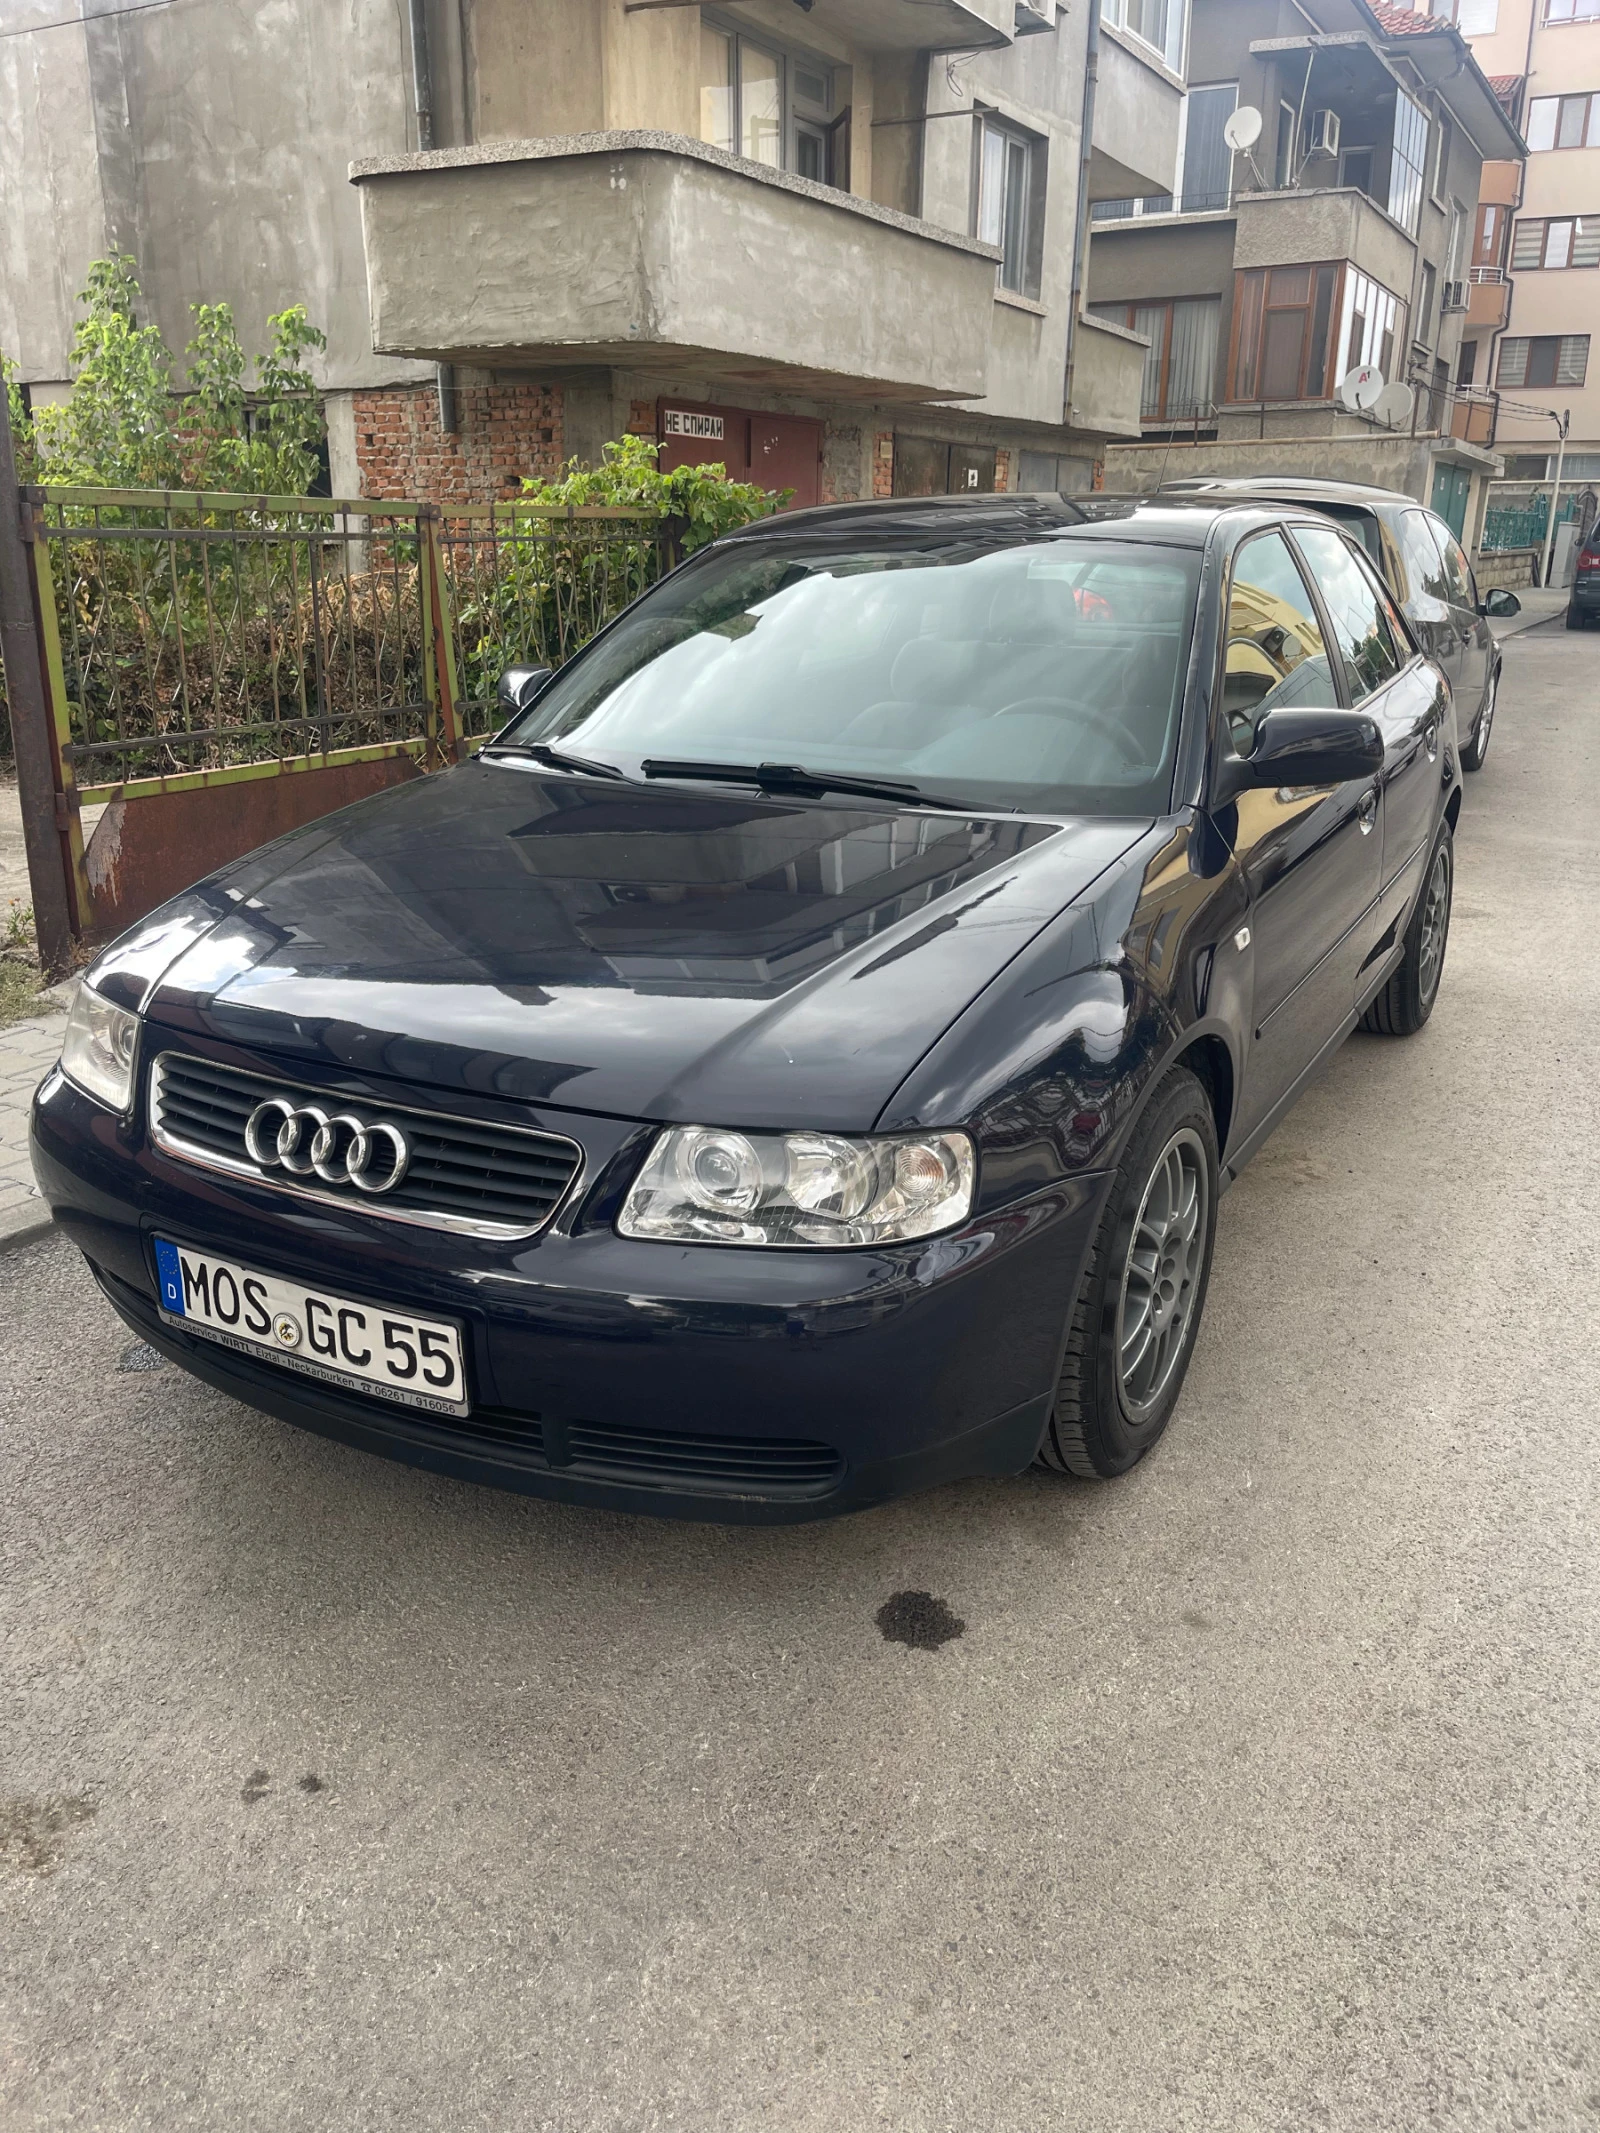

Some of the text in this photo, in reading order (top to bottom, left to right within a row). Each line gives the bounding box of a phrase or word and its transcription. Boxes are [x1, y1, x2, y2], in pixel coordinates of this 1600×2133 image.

[665, 412, 680, 432] НЕ
[167, 1282, 177, 1299] D
[180, 1256, 455, 1388] MOS GC 55
[169, 1316, 218, 1341] Autoservice
[220, 1334, 253, 1354] WIRTL
[256, 1346, 280, 1364] Elztal
[287, 1358, 355, 1388] Neckarburken
[375, 1386, 406, 1402] 06261
[415, 1396, 456, 1414] 916056
